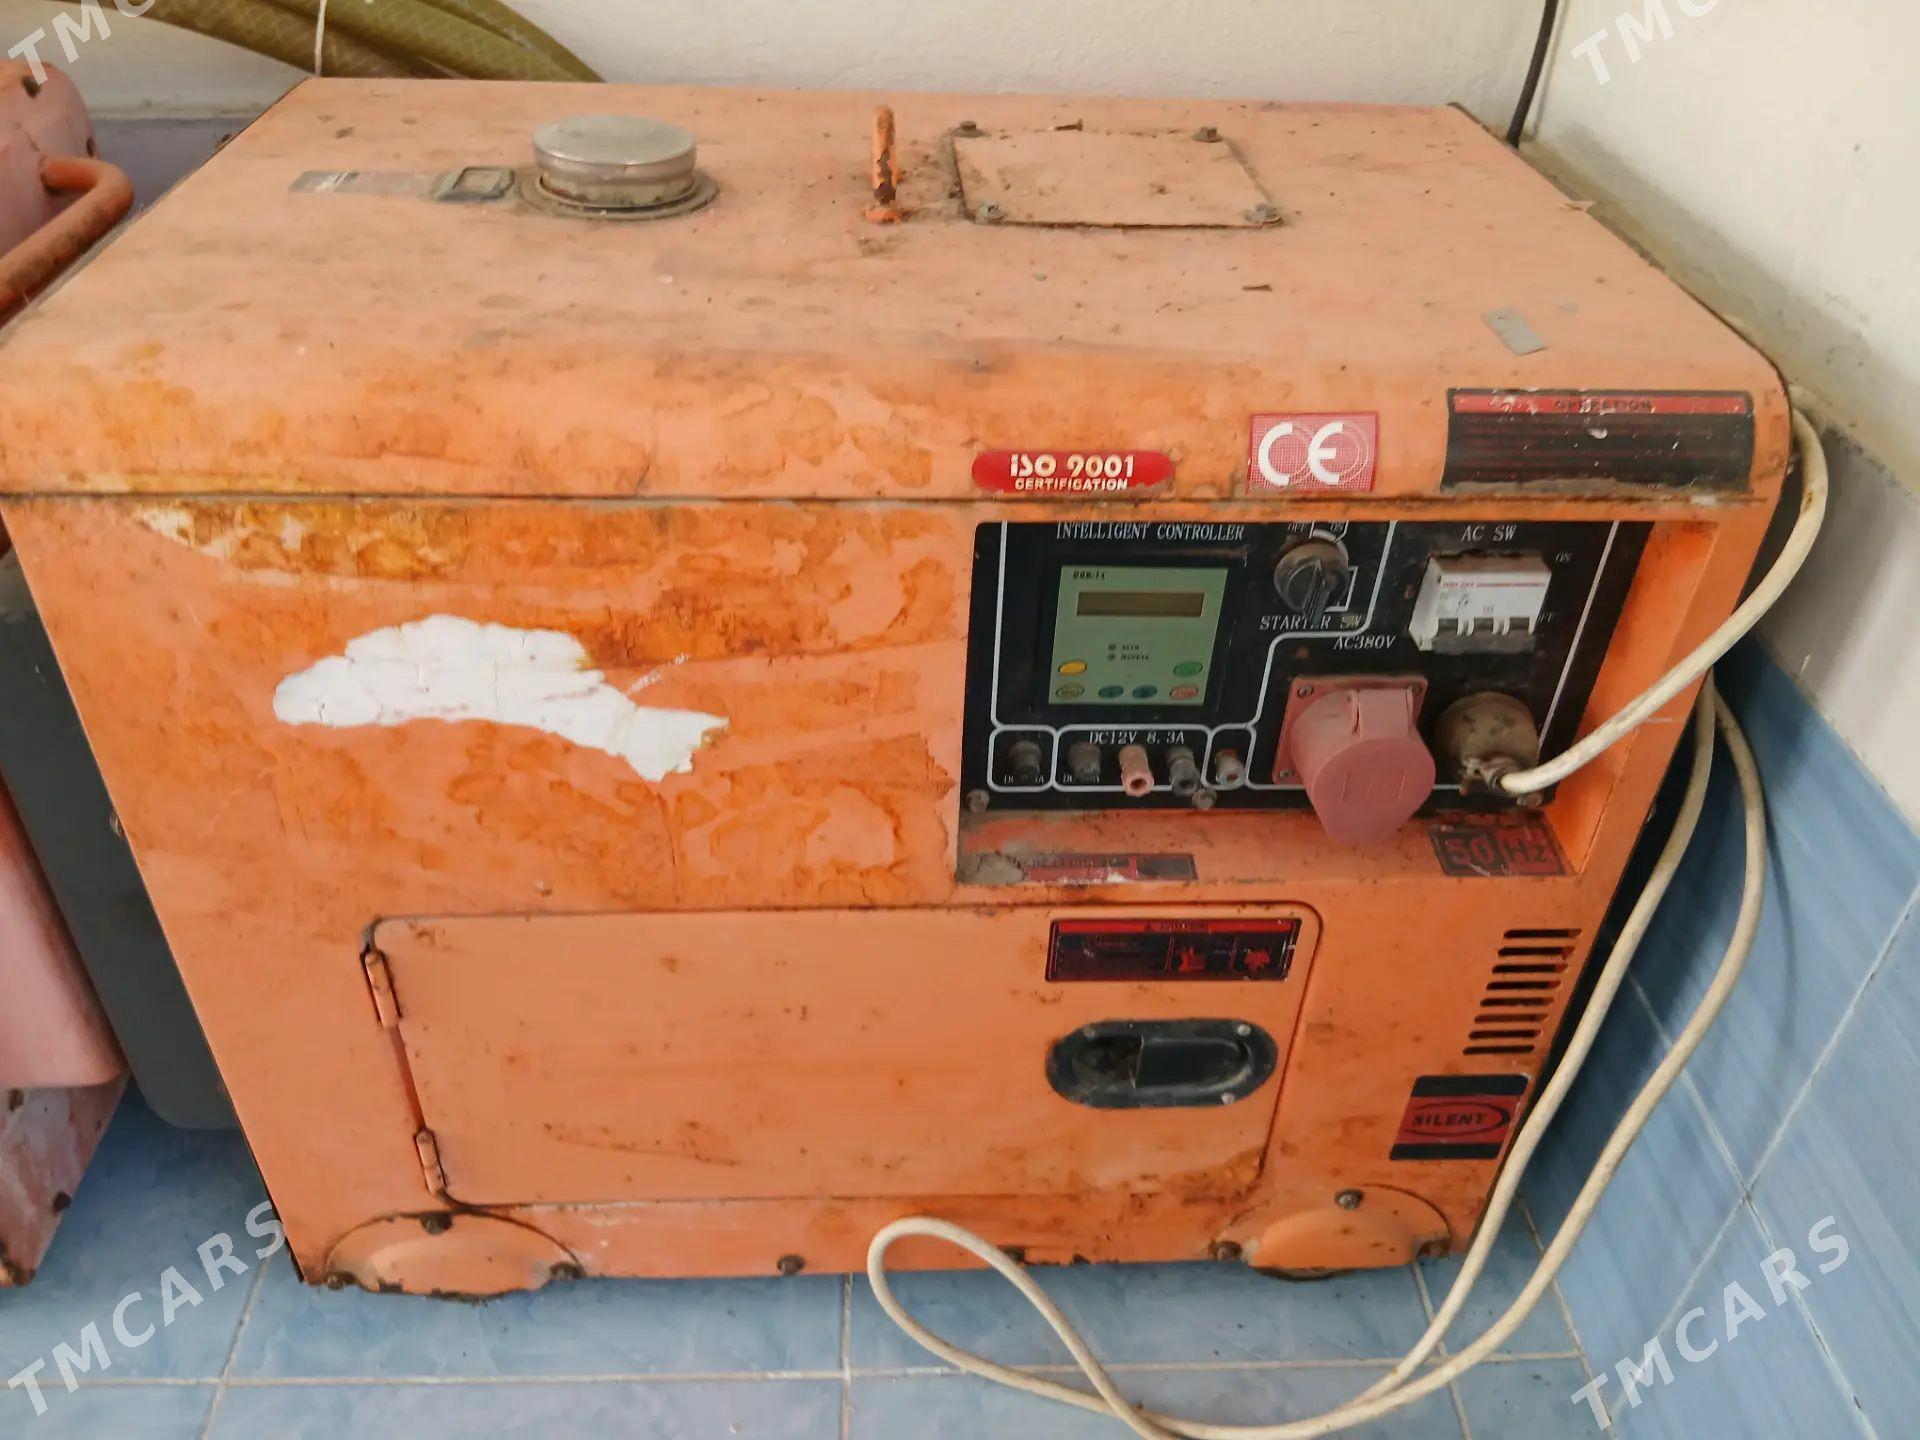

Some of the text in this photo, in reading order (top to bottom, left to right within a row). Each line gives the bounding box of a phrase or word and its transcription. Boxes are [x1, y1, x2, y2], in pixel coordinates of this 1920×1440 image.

[1257, 420, 1344, 487] CE
[1009, 453, 1135, 478] ISO 9001
[1014, 476, 1128, 492] CERTIFICATION
[1055, 522, 1245, 542] INTELLIGENT CONTROLLER
[1460, 524, 1519, 542] AC SW
[1259, 613, 1333, 631] STARTR
[1332, 634, 1396, 650] AC380V
[1088, 730, 1138, 745] DC12V
[1444, 837, 1496, 867] 50
[1411, 1112, 1490, 1127] SILENT
